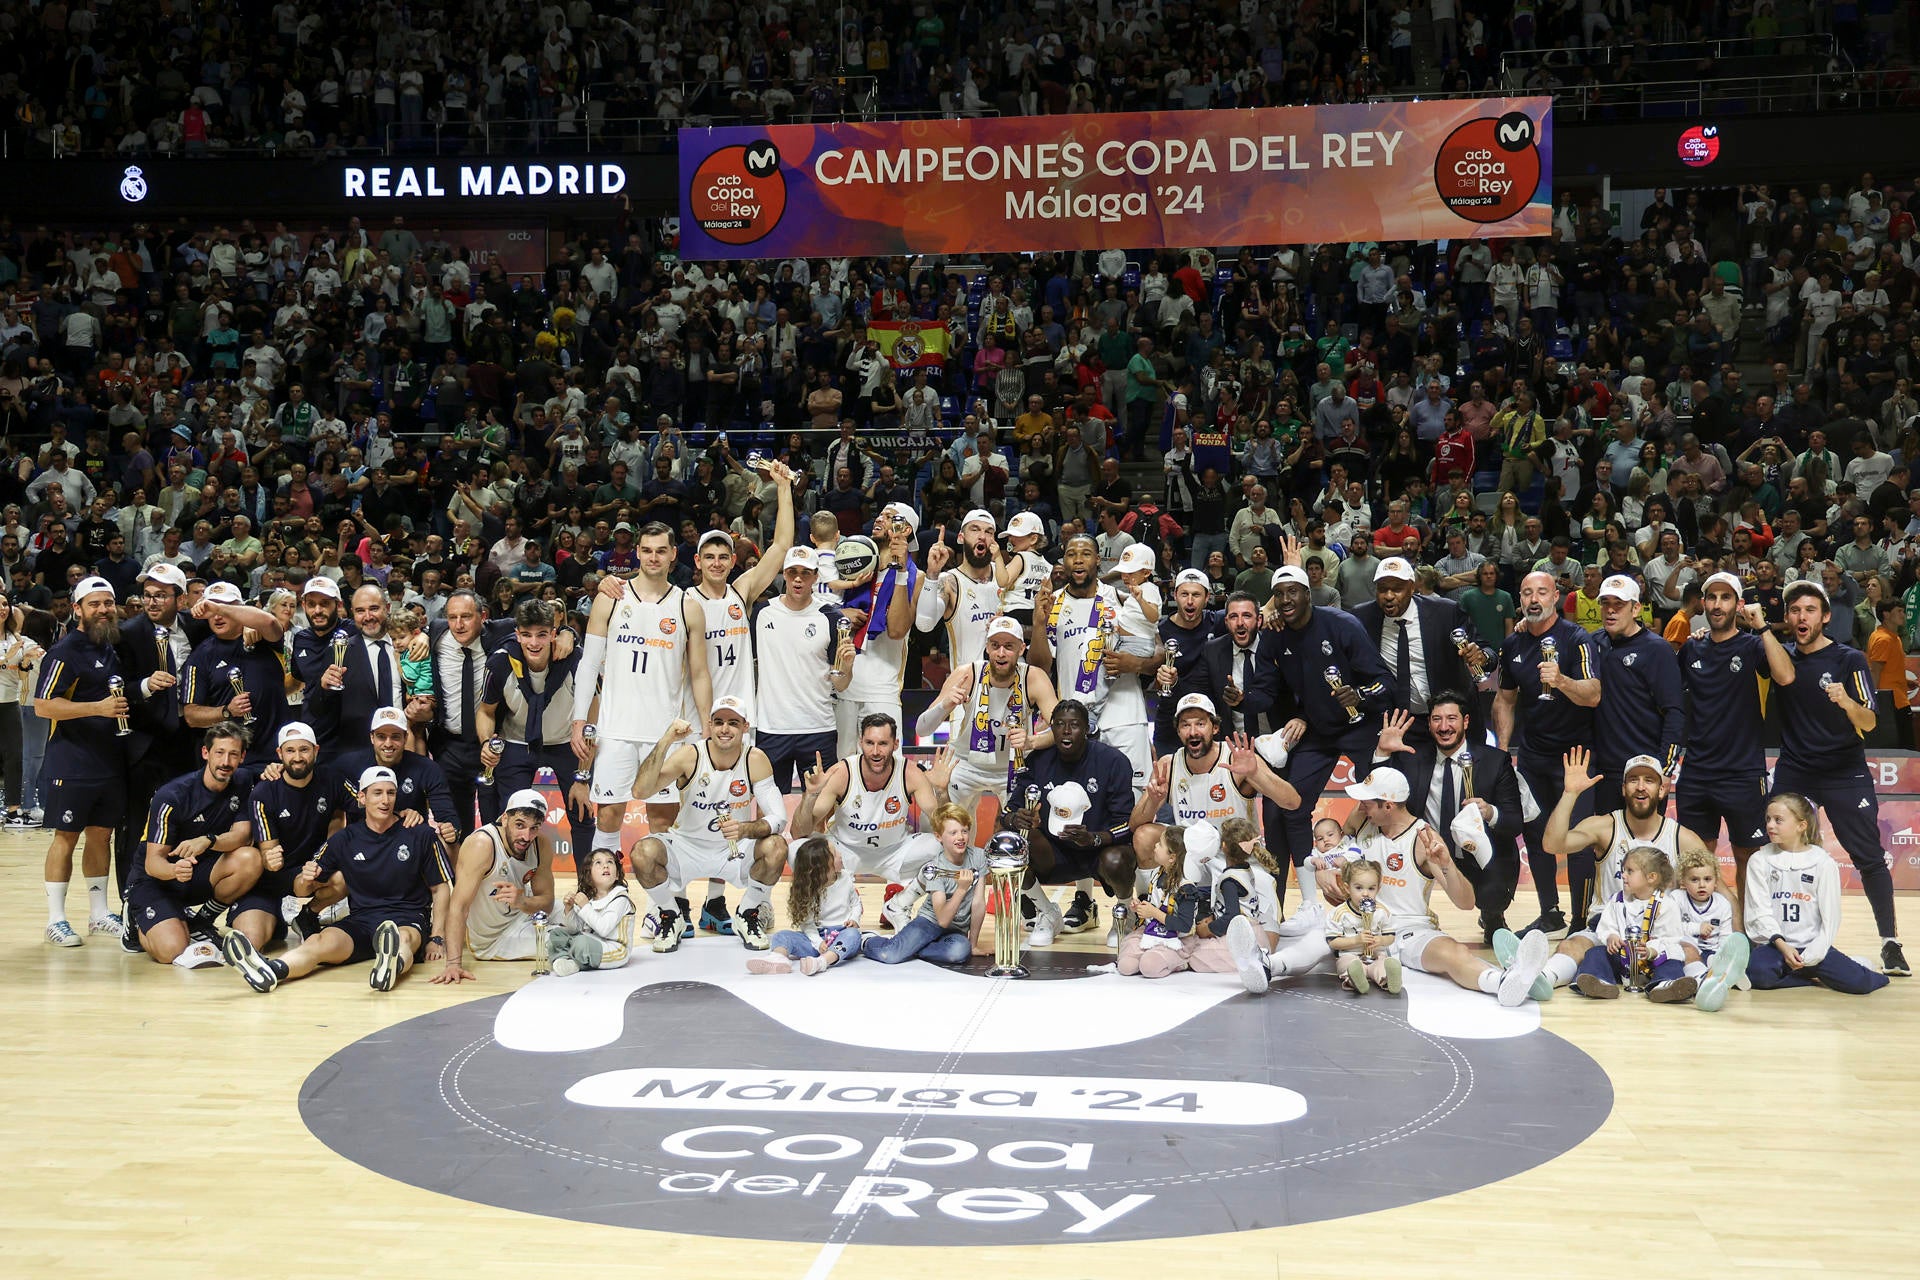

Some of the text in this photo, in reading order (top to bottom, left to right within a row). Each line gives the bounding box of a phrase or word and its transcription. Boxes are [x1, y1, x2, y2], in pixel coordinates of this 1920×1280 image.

[815, 130, 1404, 186] CAMPEONES COPA DEL REY
[1465, 149, 1492, 160] acb
[1454, 161, 1505, 177] Copa
[345, 165, 626, 197] REAL MADRID
[716, 175, 742, 186] acb
[1457, 178, 1513, 195] del Rey
[707, 186, 754, 202] Copa
[710, 202, 761, 219] del Rey
[1005, 186, 1148, 222] Málaga
[870, 436, 935, 448] UNICAJA
[1195, 438, 1227, 446] RONDA
[616, 634, 675, 650] AUTOHERO
[631, 650, 648, 674] 11
[715, 643, 737, 667] 14
[1179, 806, 1235, 819] AUTOHERO
[848, 816, 906, 831] AUTOHERO
[867, 835, 880, 848] 5
[1781, 903, 1800, 922] 13
[632, 1078, 1038, 1109] Málaga
[660, 1125, 1094, 1172] Copa
[658, 1169, 1158, 1235] del Rey
